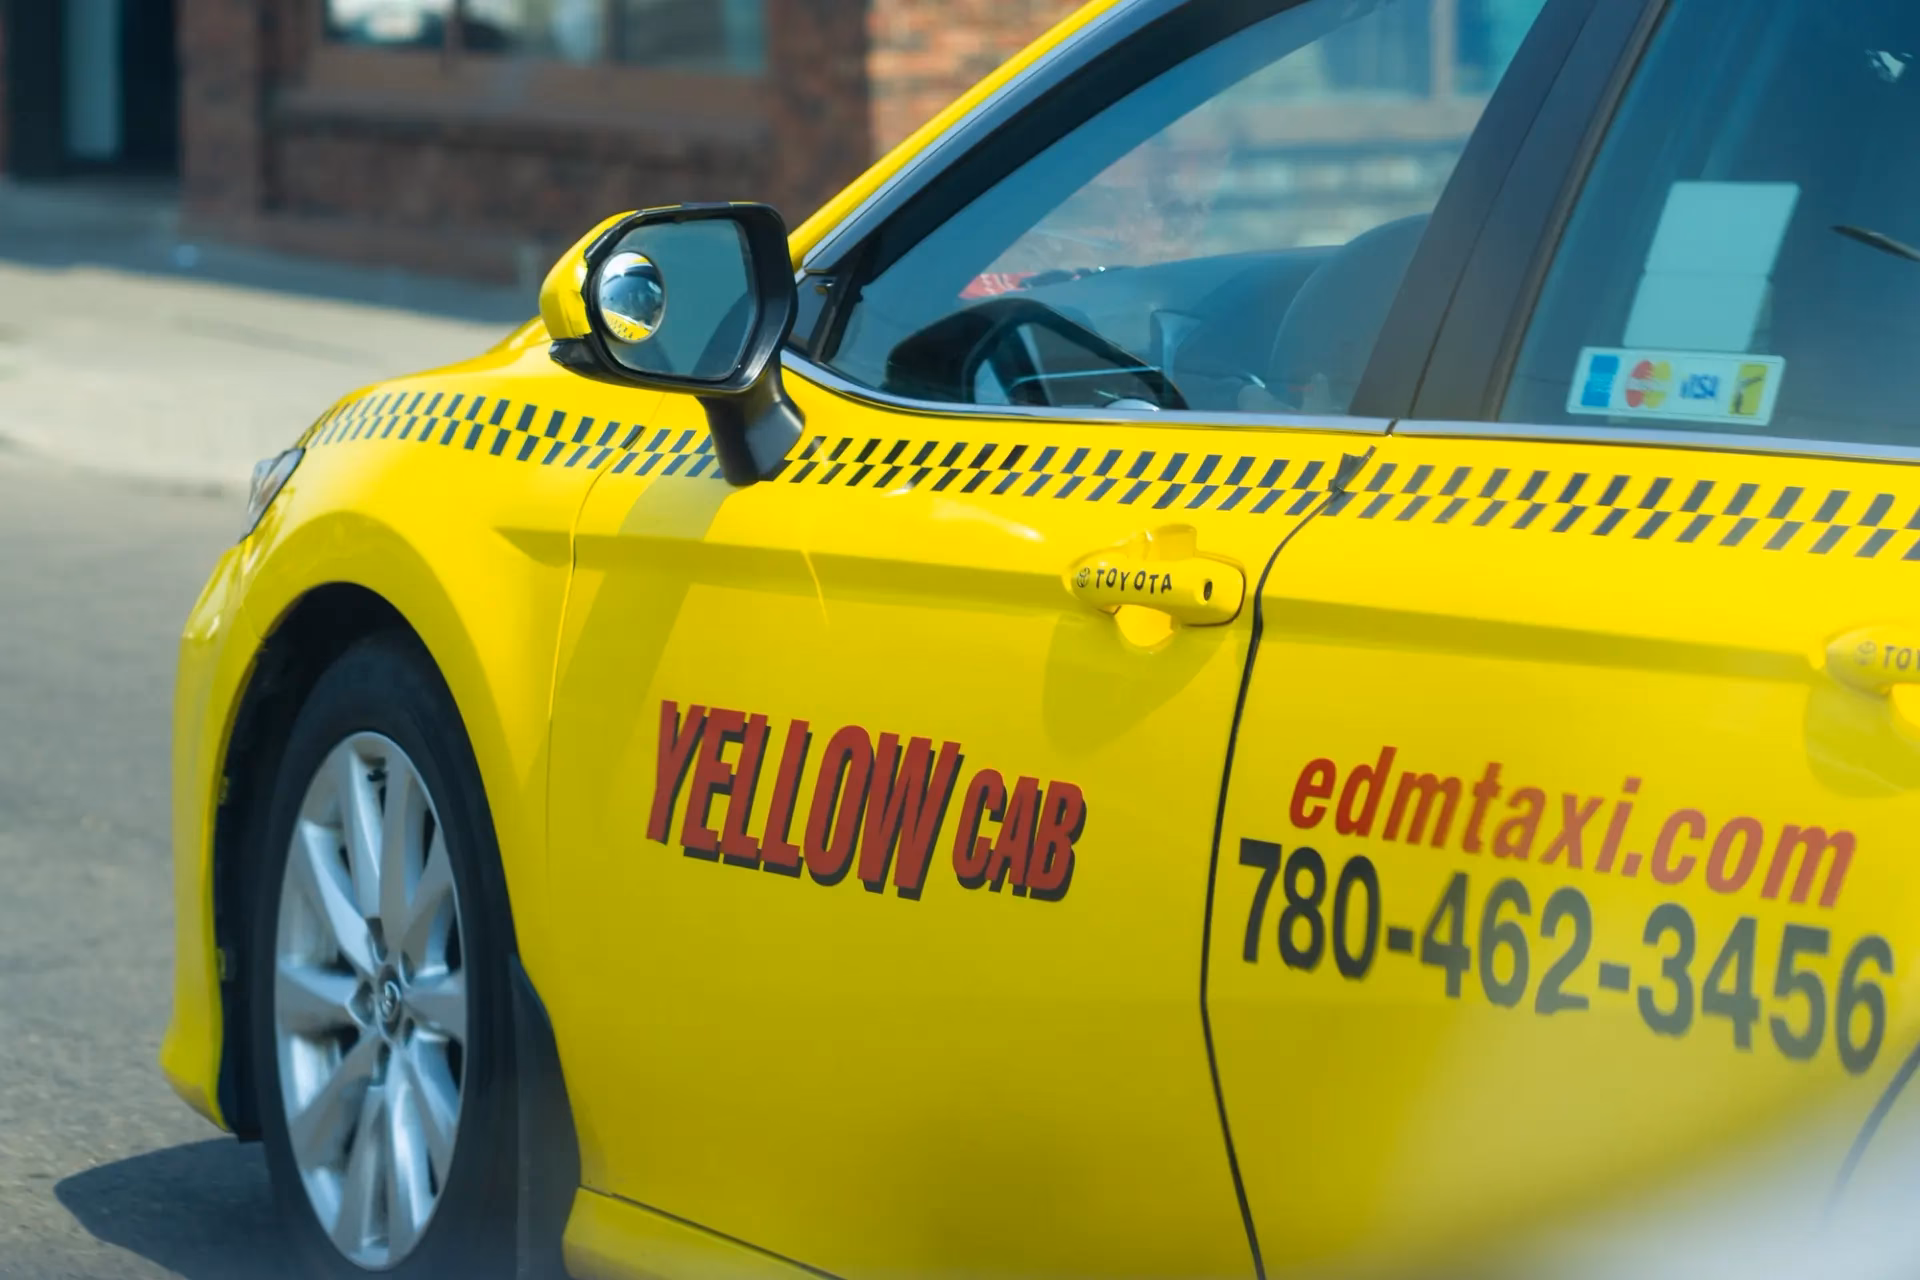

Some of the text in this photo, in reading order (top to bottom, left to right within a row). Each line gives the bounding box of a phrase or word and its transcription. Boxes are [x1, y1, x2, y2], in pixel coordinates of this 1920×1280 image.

[1095, 567, 1173, 594] TOYOTA
[1883, 645, 1920, 671] TO
[646, 699, 1087, 903] YELLOW CAB
[1288, 746, 1857, 909] edmtaxi.com
[1238, 836, 1895, 1076] 780-462-3456
